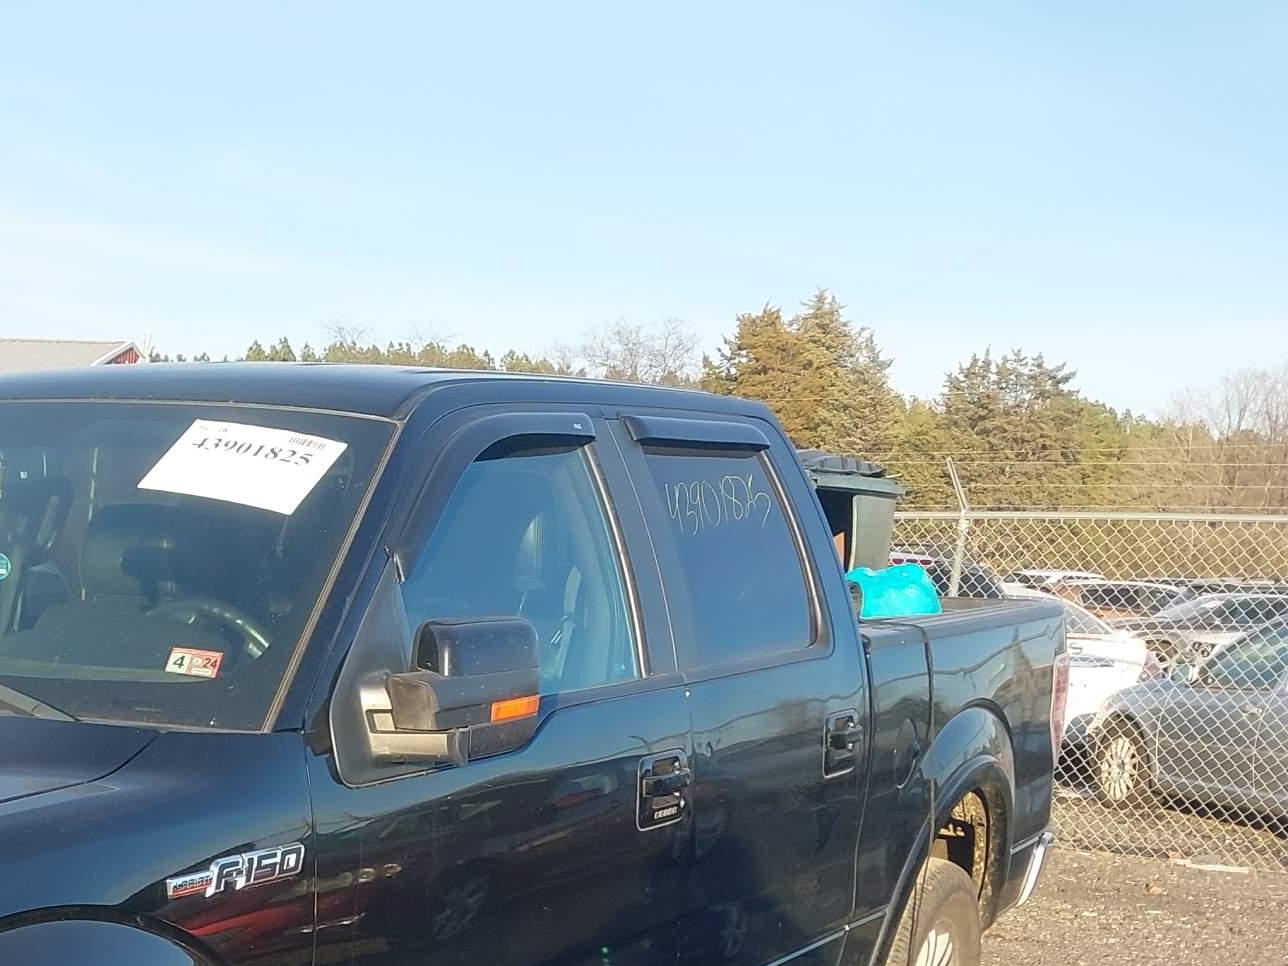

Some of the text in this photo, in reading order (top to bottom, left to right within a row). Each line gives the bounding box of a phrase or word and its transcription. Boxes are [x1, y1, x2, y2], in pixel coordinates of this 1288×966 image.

[193, 438, 314, 465] 43901825
[173, 655, 219, 670] 4 24
